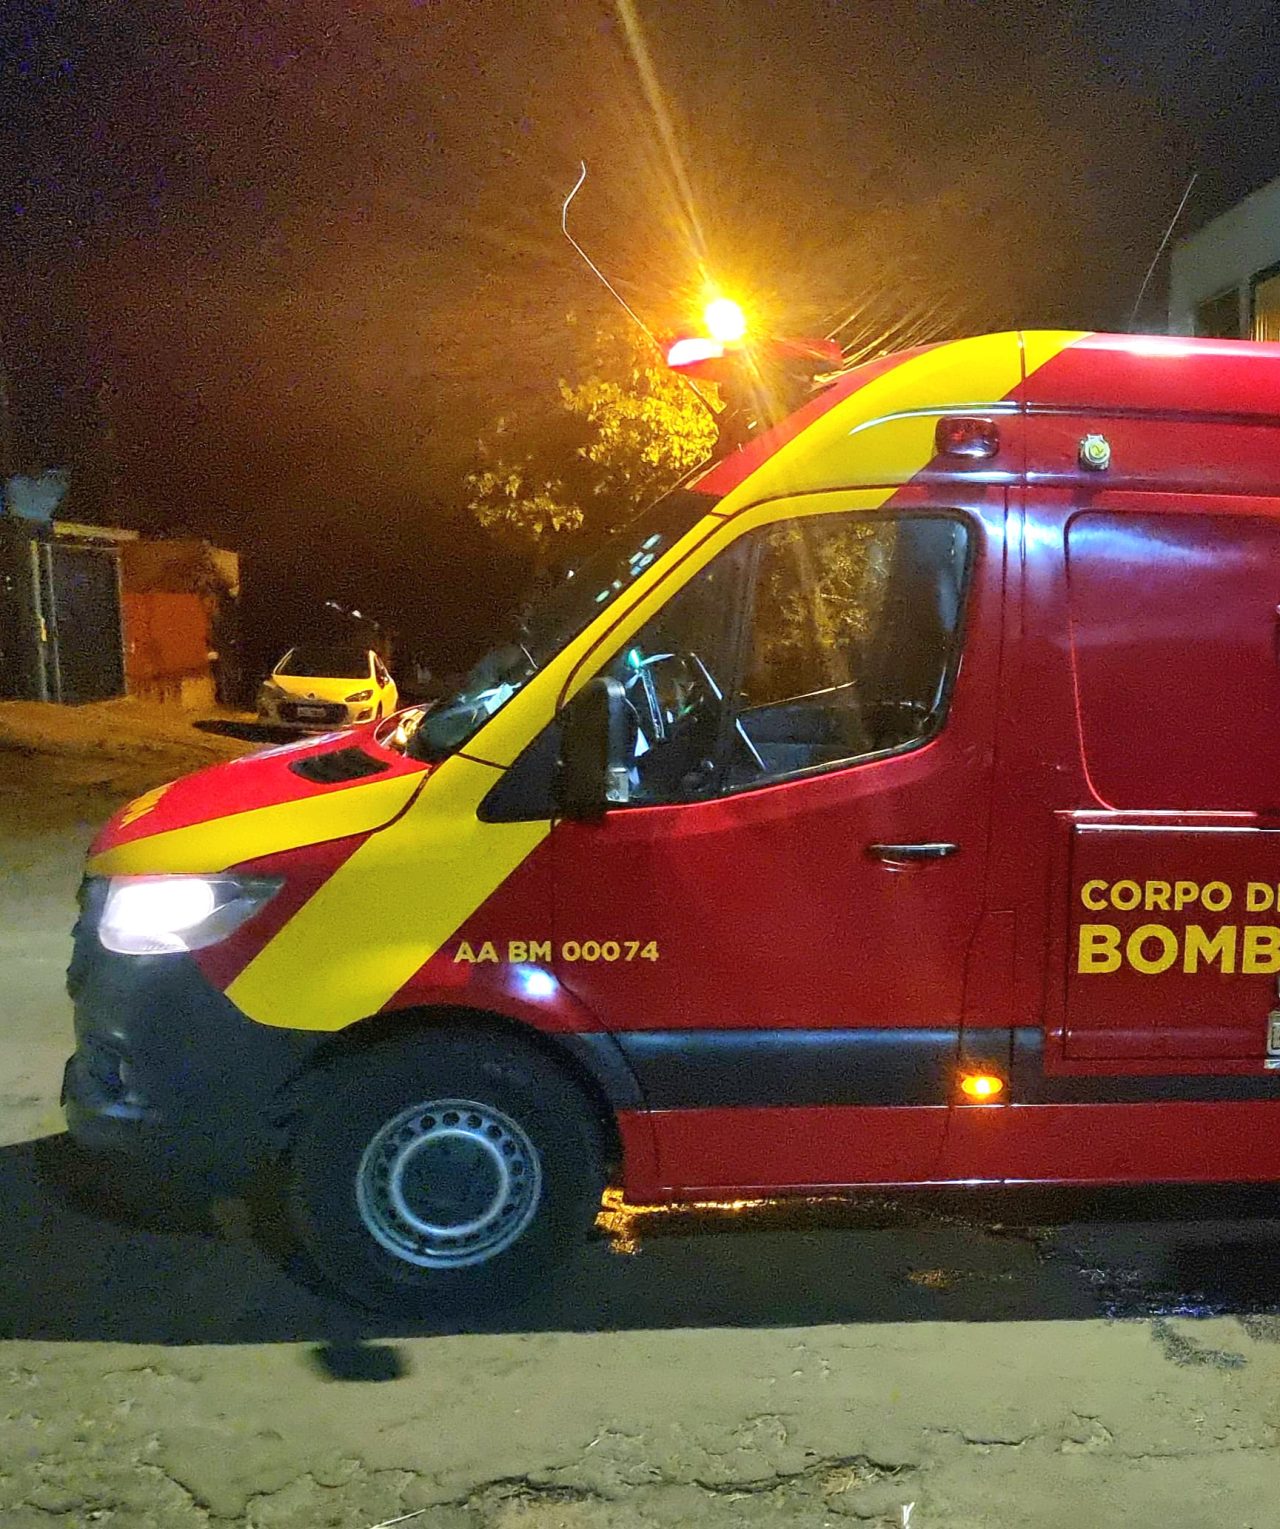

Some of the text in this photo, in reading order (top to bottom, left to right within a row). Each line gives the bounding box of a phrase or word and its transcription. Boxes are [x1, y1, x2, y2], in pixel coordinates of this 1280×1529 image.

[1080, 879, 1233, 912] CORPO
[453, 940, 660, 963] AA BM 00074
